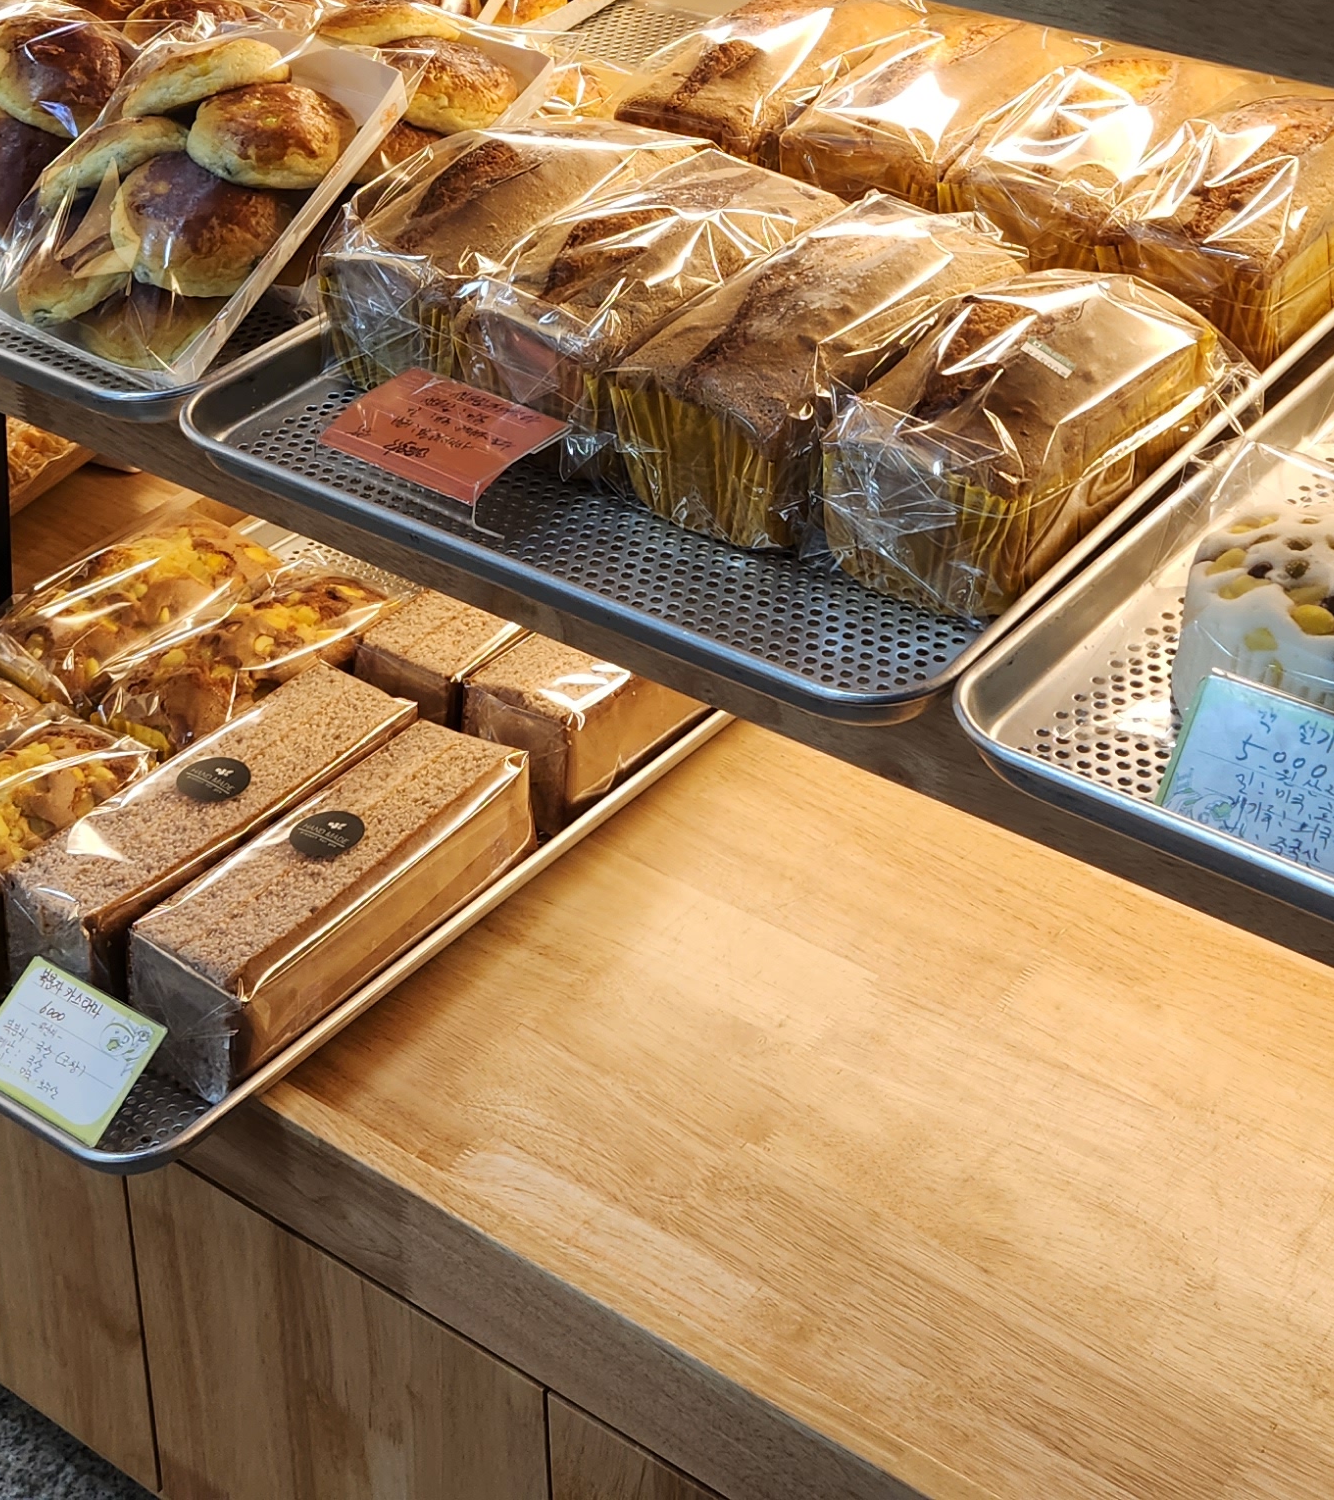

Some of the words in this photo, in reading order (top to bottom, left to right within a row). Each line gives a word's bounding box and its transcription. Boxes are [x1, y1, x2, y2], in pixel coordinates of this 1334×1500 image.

[1236, 735, 1327, 778] 5000
[211, 776, 235, 792] MADE
[324, 831, 349, 845] MADE
[39, 1001, 66, 1022] 6000
